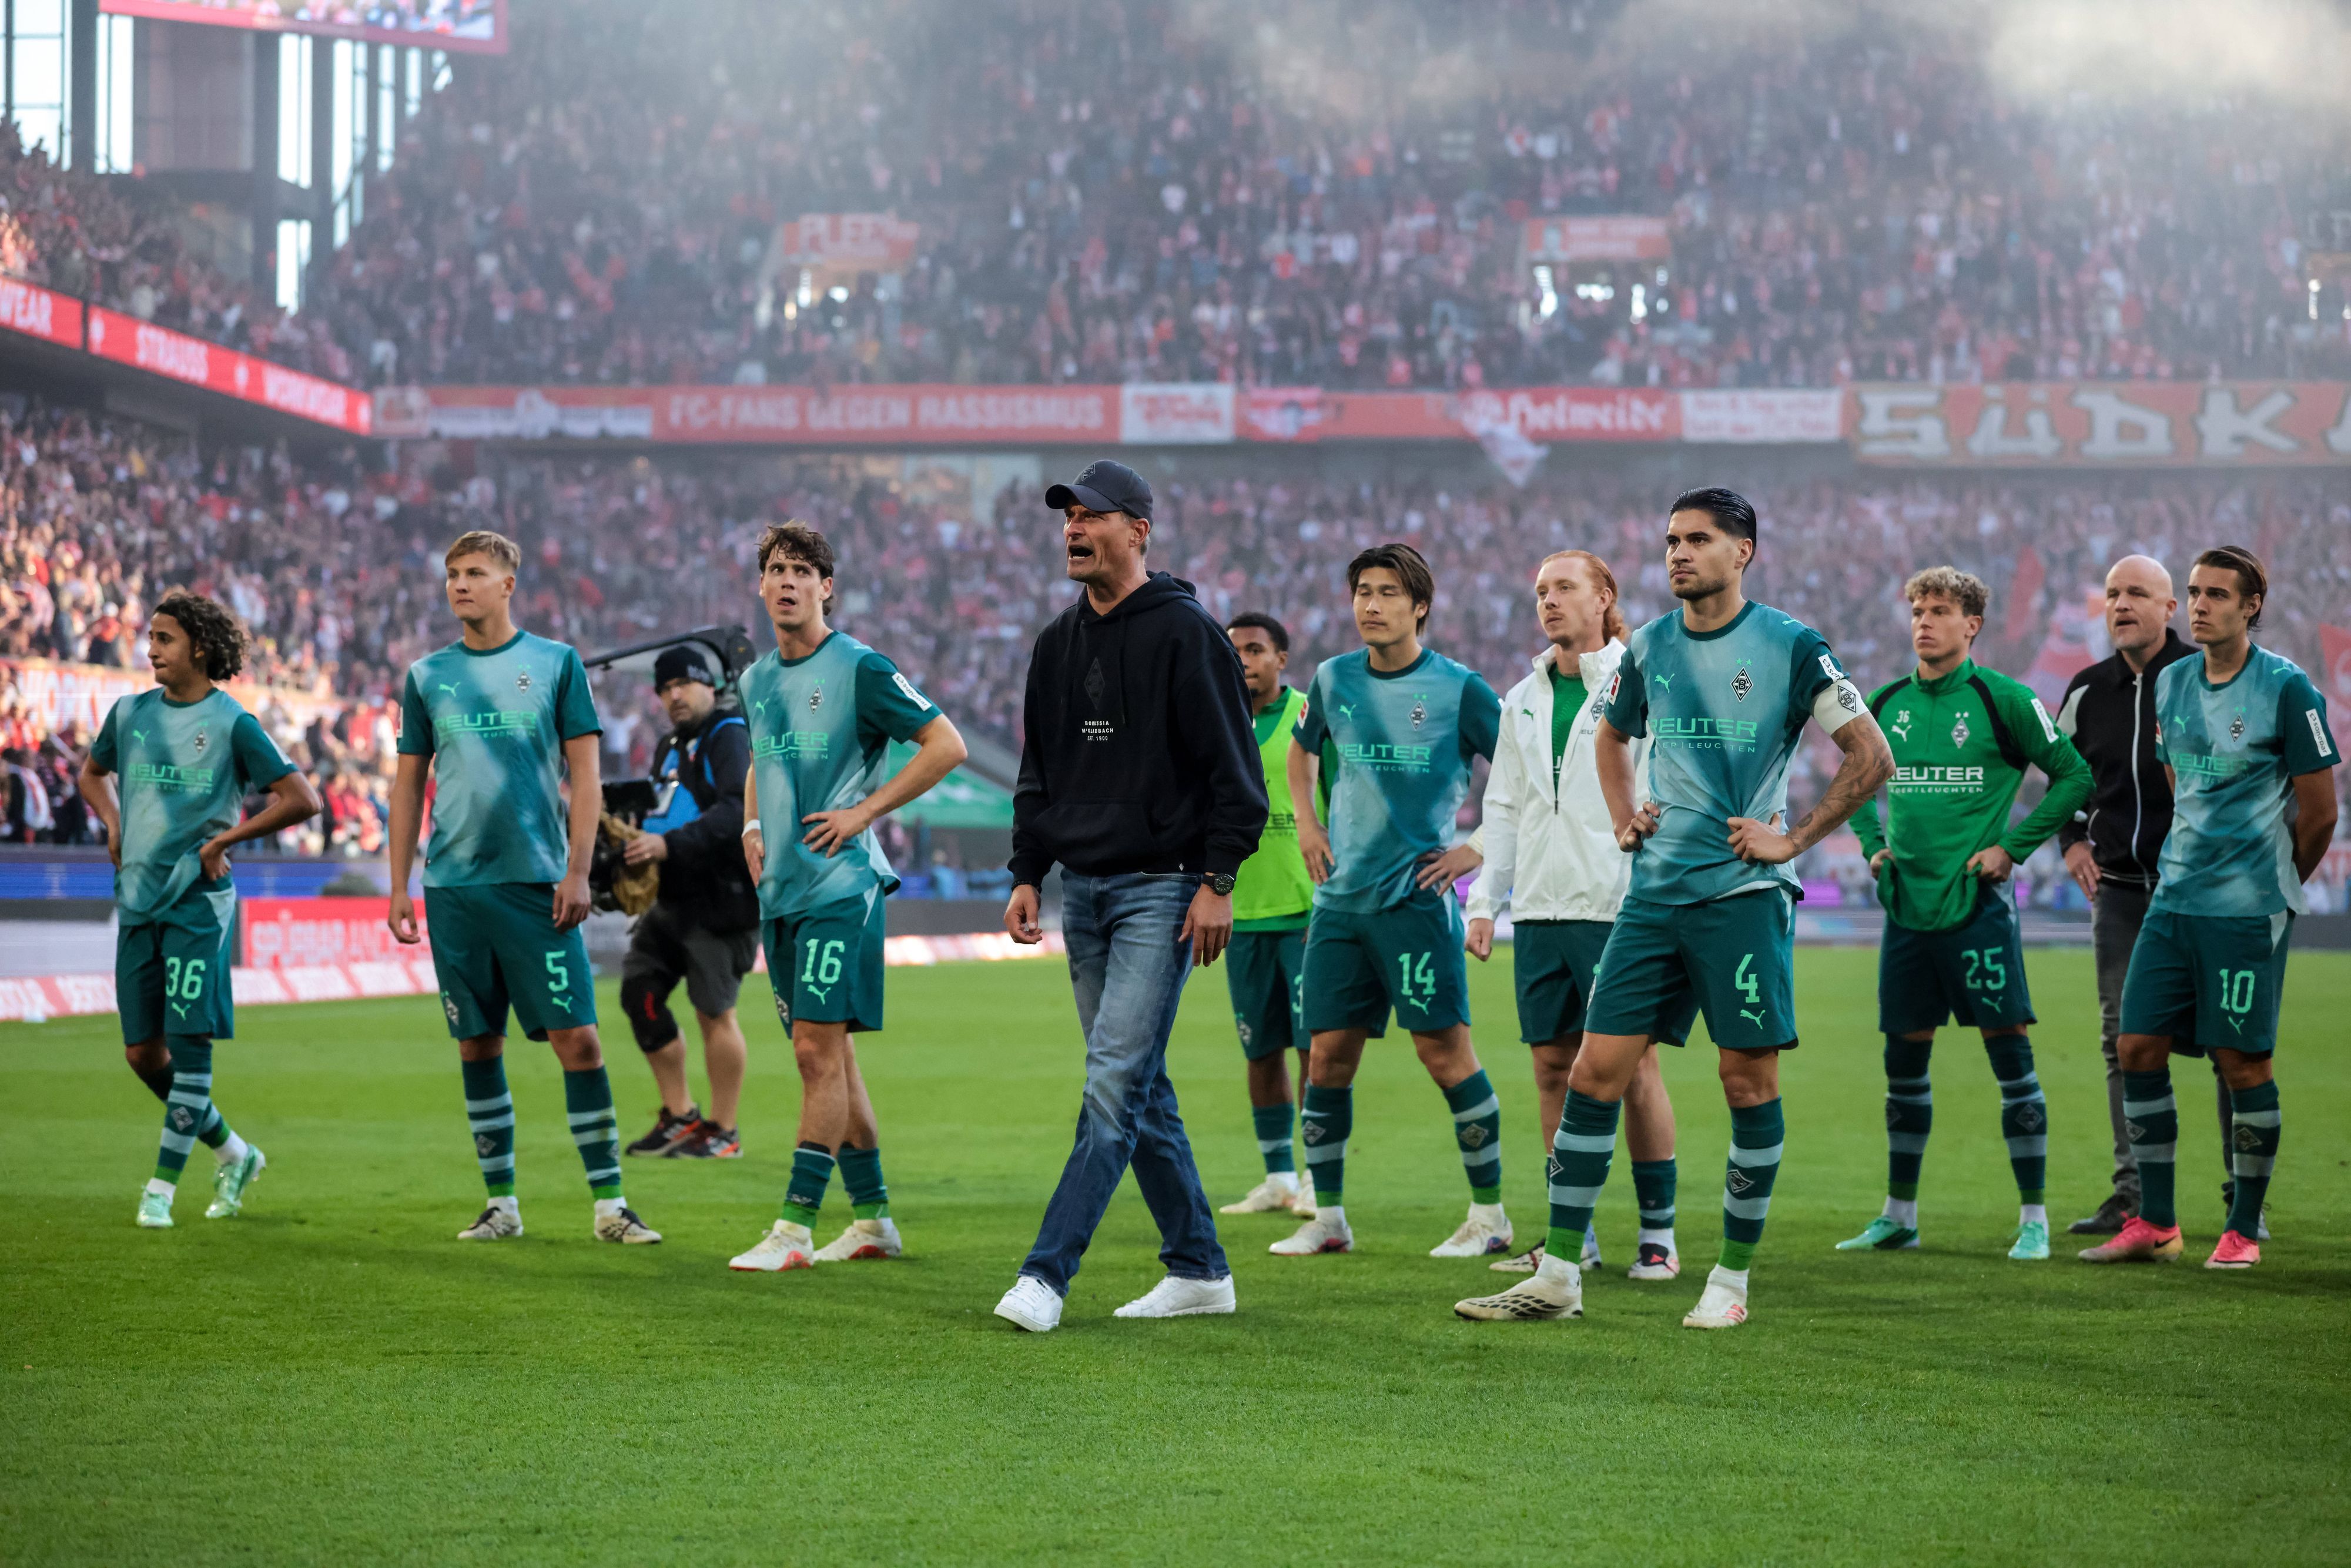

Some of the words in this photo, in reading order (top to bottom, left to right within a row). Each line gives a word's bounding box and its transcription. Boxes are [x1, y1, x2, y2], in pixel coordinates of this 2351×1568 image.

[1896, 710, 1910, 723] 36
[2313, 722, 2327, 753] sonepar
[1689, 742, 1755, 753] LEUCTEN
[1891, 766, 1984, 780] EUTER
[166, 957, 206, 999] 36
[545, 950, 568, 992] 5
[801, 939, 845, 984] 16
[1398, 952, 1436, 996] 14
[1735, 954, 1760, 1003] 4
[1961, 947, 2005, 990] 25
[2219, 969, 2255, 1013] 10
